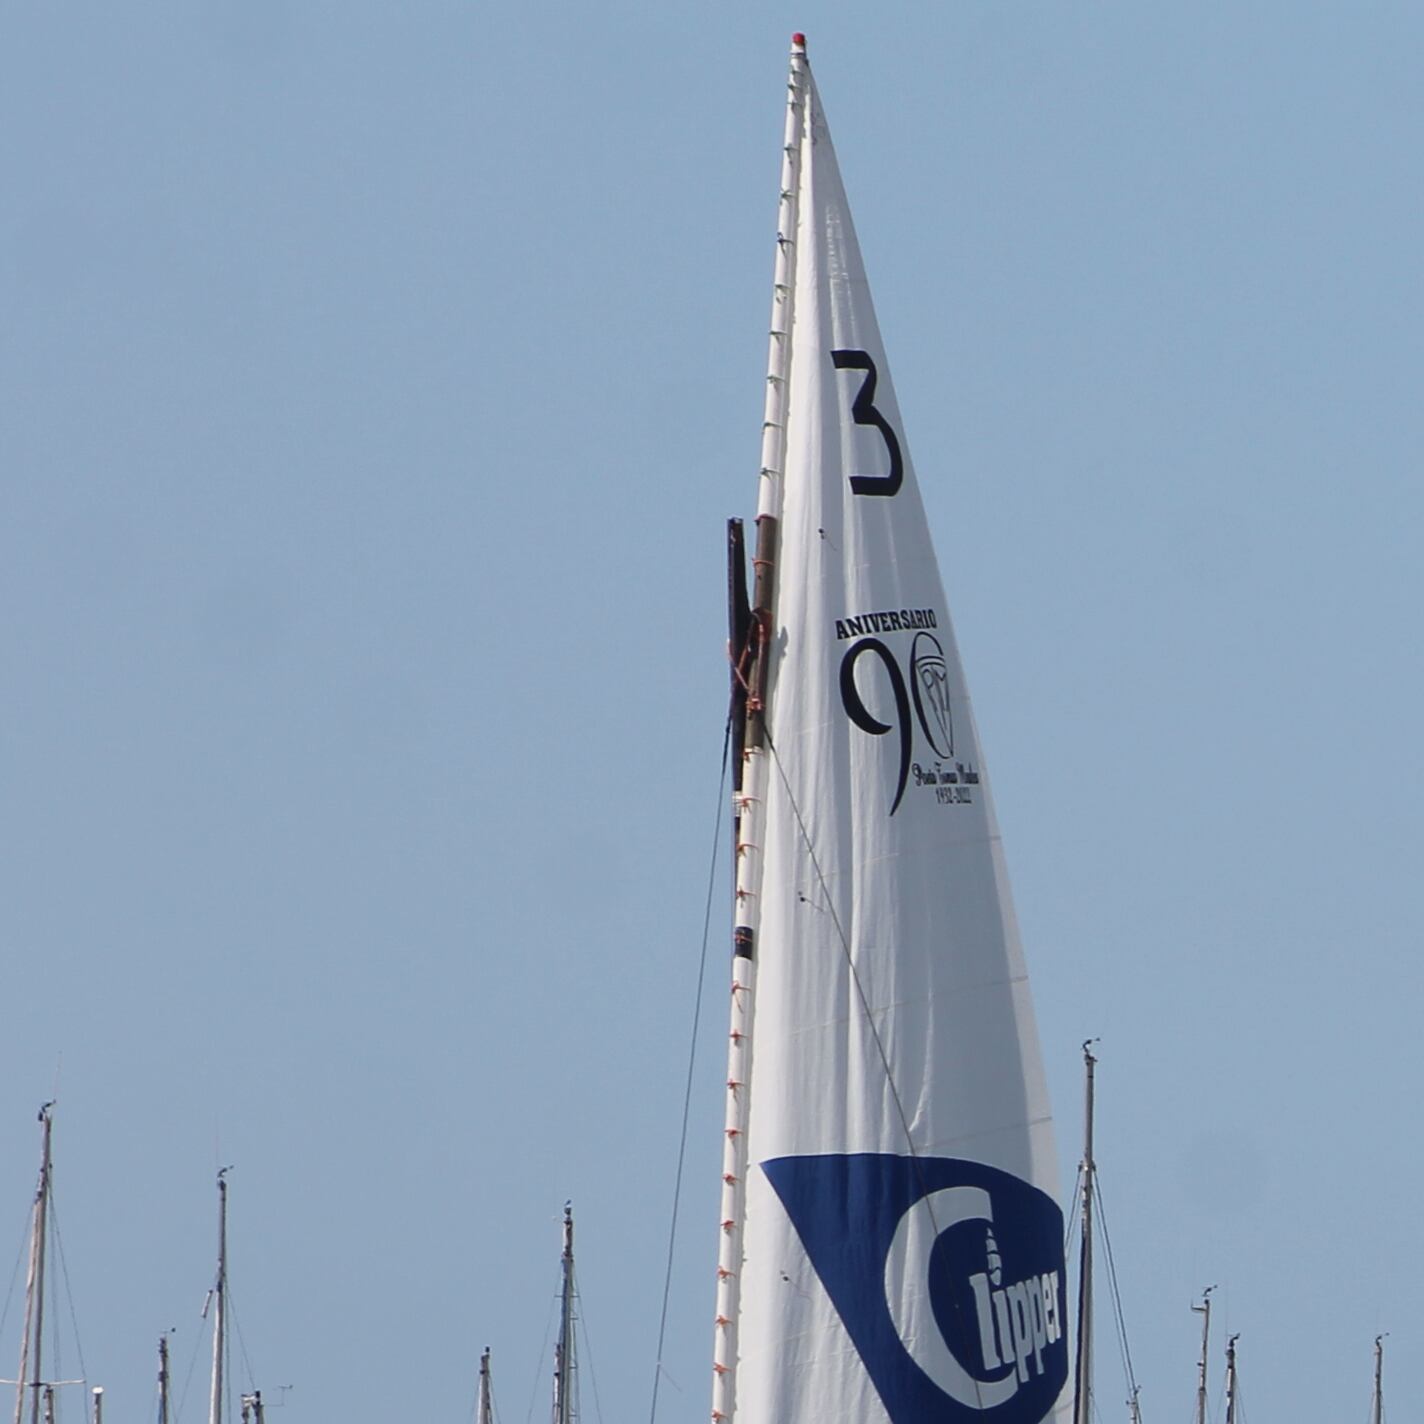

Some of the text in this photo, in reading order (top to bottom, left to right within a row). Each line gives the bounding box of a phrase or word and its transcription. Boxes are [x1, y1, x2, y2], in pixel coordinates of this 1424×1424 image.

[830, 350, 904, 497] 3
[835, 609, 938, 641] ANIVERSARIO
[884, 1185, 1062, 1411] Clipper
